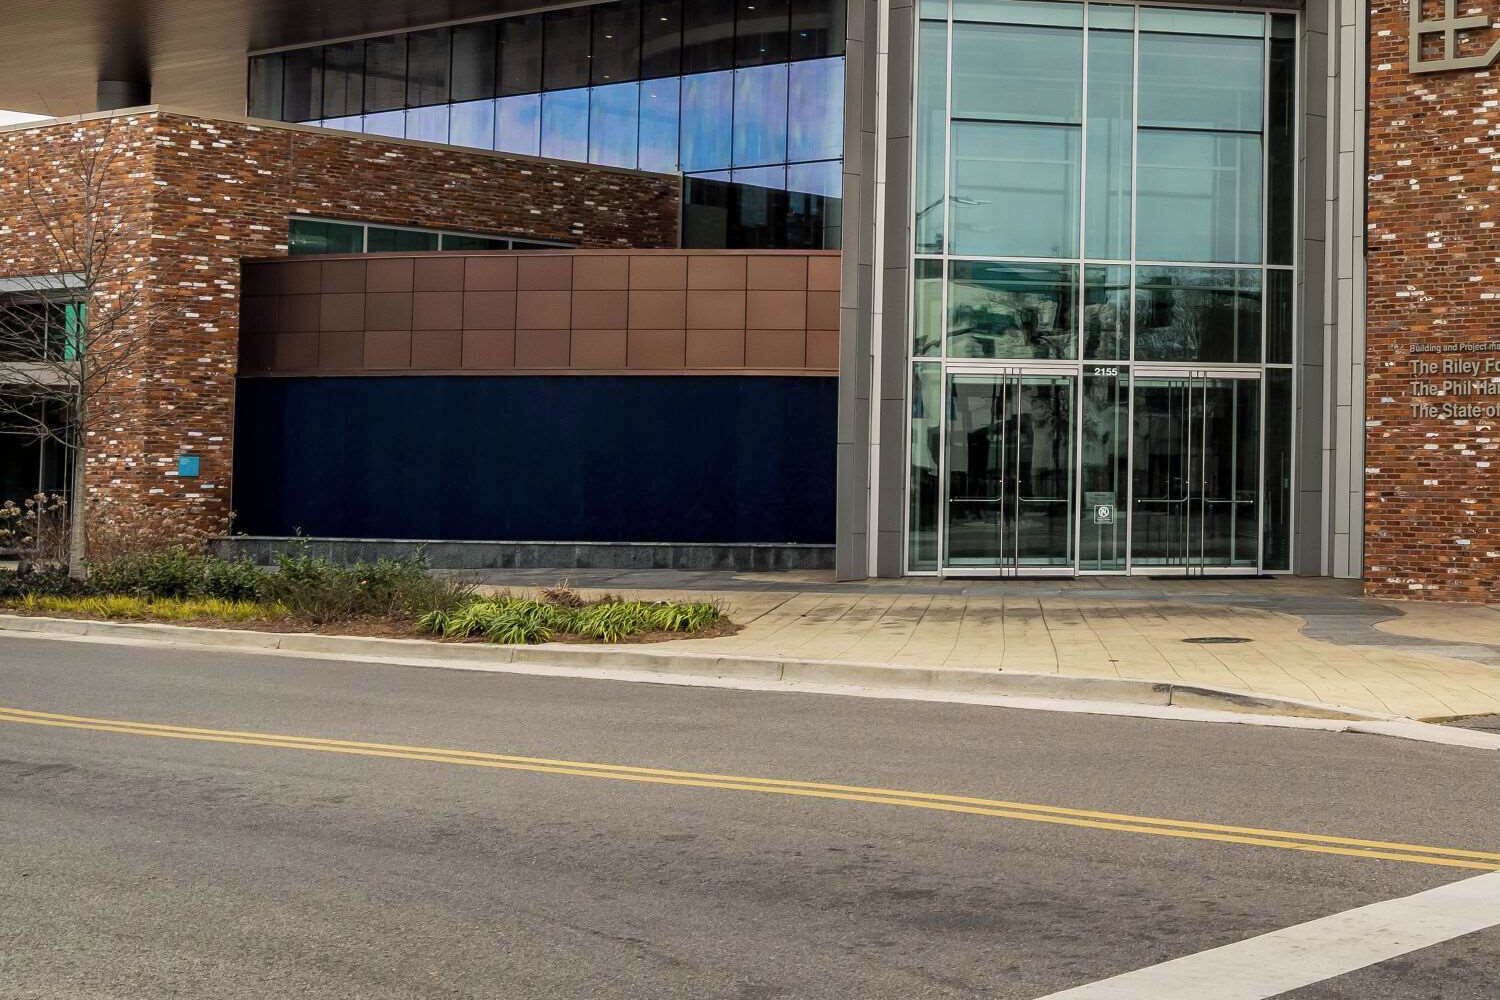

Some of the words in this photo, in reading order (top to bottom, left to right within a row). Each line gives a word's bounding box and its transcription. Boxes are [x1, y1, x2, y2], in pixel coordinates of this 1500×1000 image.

[1410, 343, 1441, 354] Building
[1443, 343, 1458, 352] and
[1460, 342, 1488, 353] Project
[1094, 367, 1118, 376] 2155
[1409, 360, 1438, 374] The
[1443, 359, 1480, 376] Riley
[1409, 381, 1438, 395] The
[1443, 380, 1472, 395] Phil
[1409, 402, 1438, 417] The
[1442, 402, 1481, 418] State
[1487, 401, 1500, 417] of
